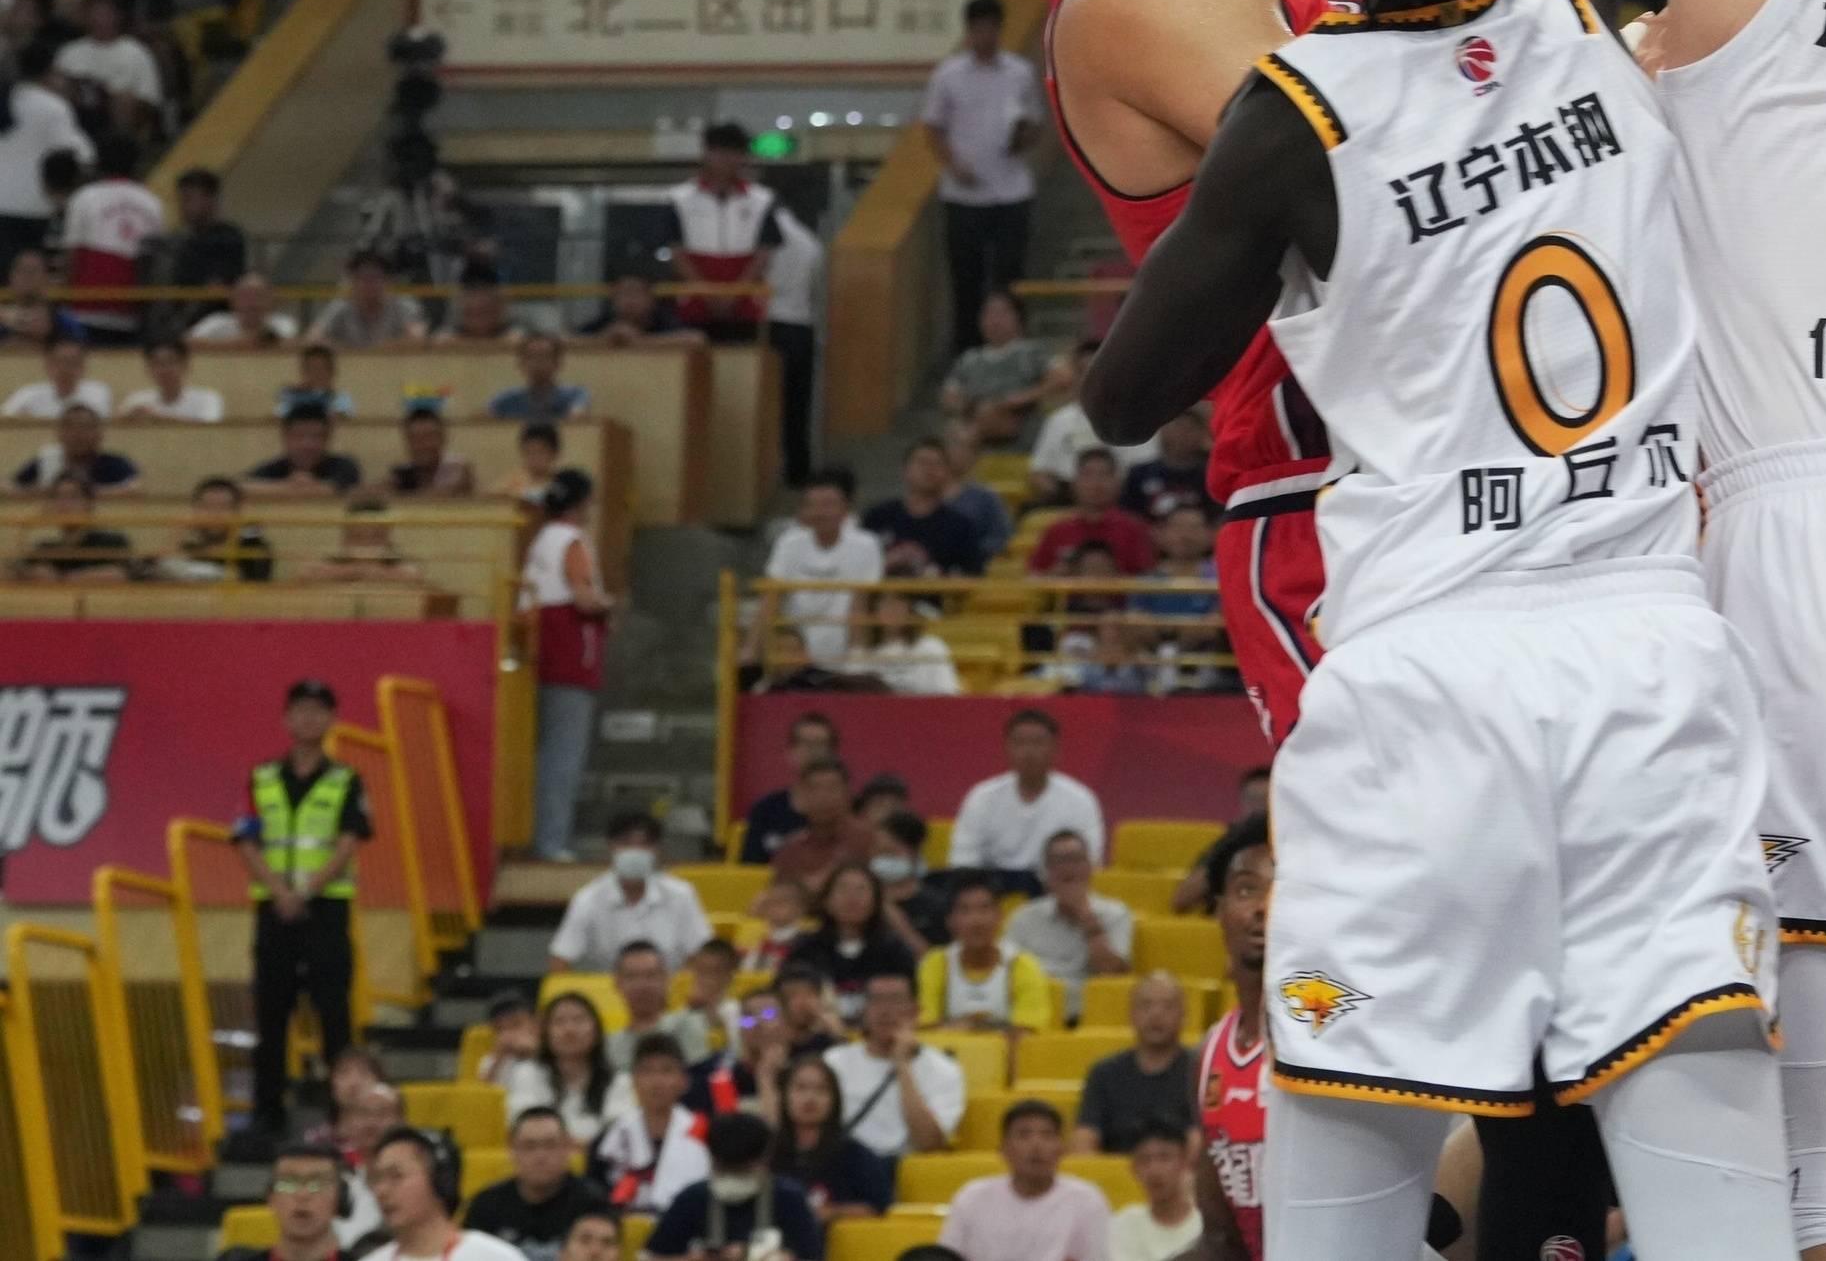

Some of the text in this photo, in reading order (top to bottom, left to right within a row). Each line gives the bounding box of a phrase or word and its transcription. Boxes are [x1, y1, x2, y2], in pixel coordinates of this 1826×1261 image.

[1388, 91, 1624, 245] 辽宁本钢
[1487, 234, 1637, 458] 0
